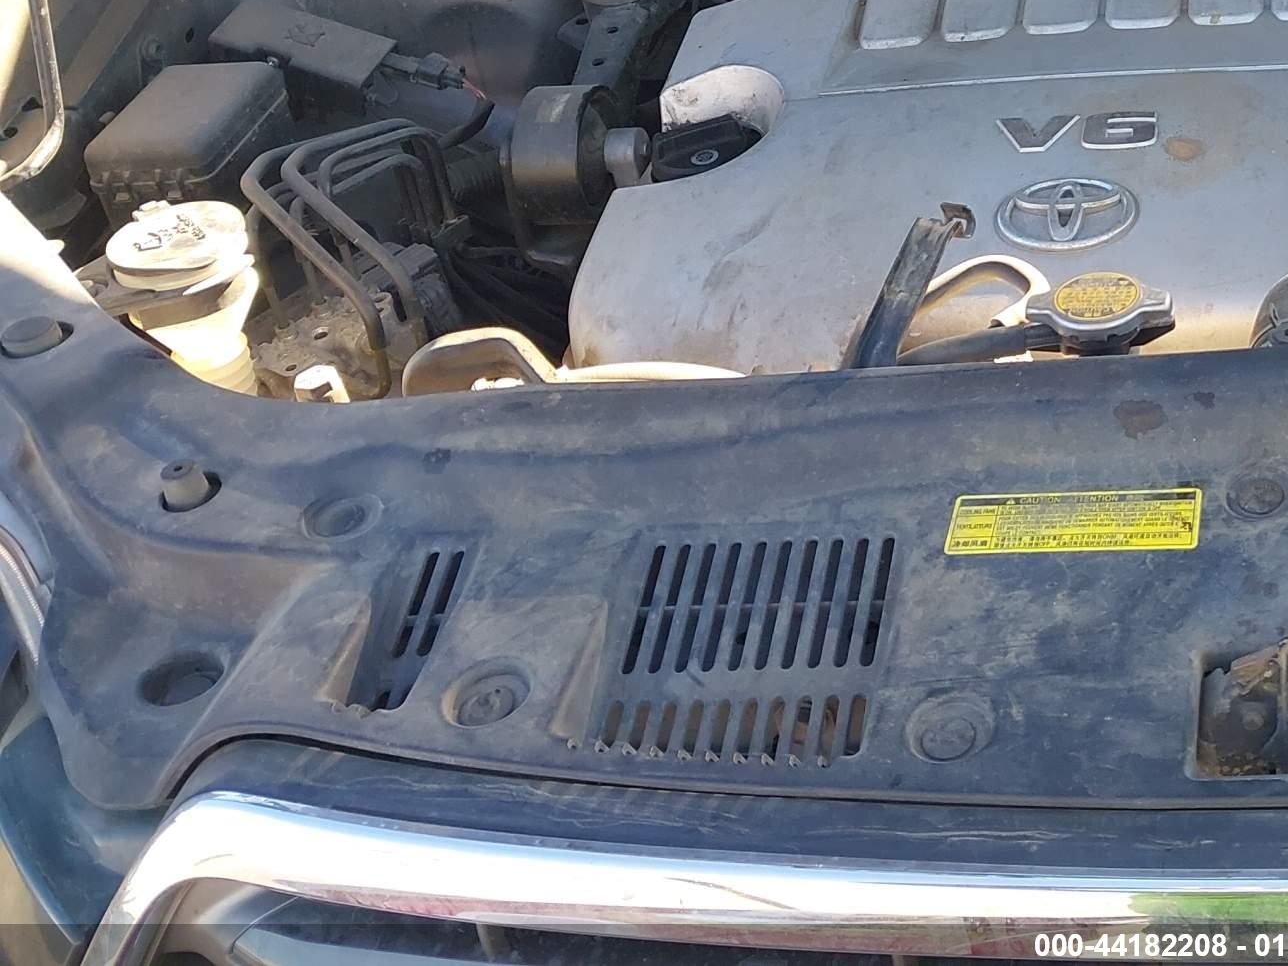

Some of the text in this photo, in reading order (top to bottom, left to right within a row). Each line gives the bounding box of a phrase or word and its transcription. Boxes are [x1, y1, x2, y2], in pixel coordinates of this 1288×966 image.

[995, 111, 1159, 153] V6
[1019, 496, 1061, 505] CAUTON
[1069, 494, 1119, 504] TTENTION
